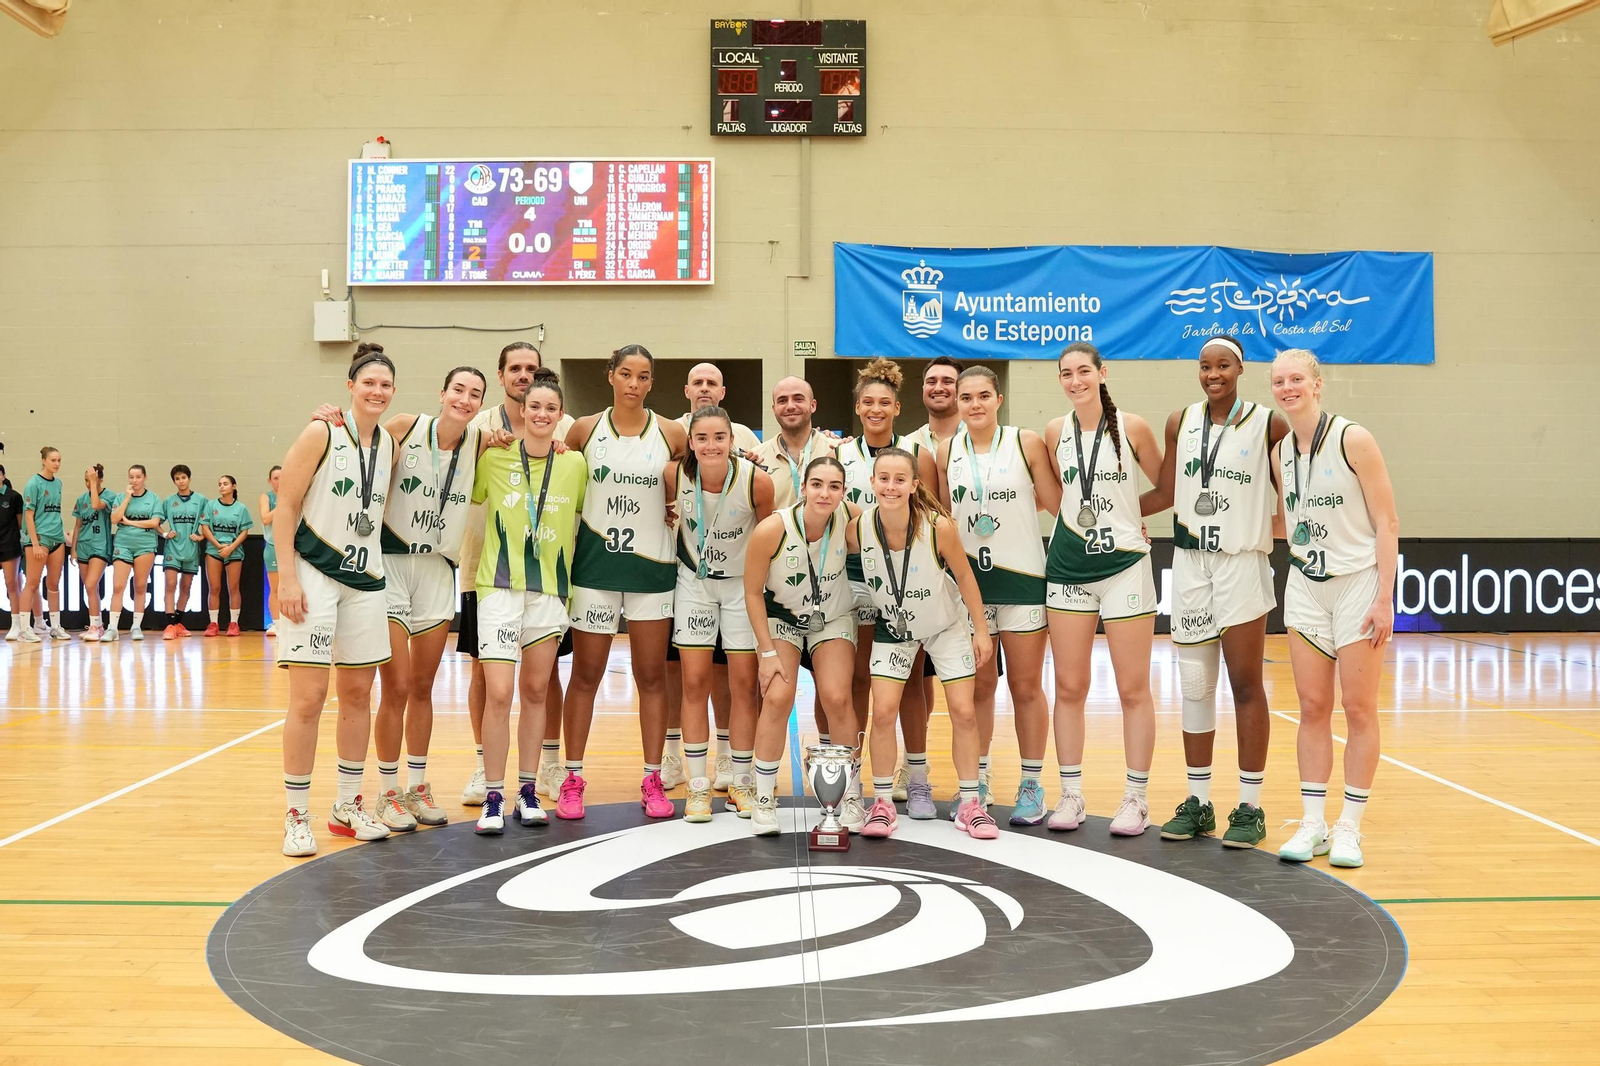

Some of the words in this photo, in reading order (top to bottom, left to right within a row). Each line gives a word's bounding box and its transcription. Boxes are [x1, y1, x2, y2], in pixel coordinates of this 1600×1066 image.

[719, 52, 759, 63] LOCAL
[818, 53, 858, 64] VISITANTE
[774, 83, 803, 92] PERIODO
[717, 123, 746, 132] FALTAS
[770, 123, 807, 132] JUGADOR
[833, 123, 862, 133] FALTAS
[498, 167, 562, 192] 73-69
[376, 185, 406, 193] PRADOS
[472, 196, 488, 206] CAB
[515, 196, 545, 205] PERIODO
[574, 196, 588, 205] UNI
[524, 207, 536, 221] 4
[628, 212, 673, 221] ZIMMERMAN
[468, 220, 482, 228] TM
[577, 220, 592, 228] TM
[629, 222, 658, 230] ROTERS
[508, 232, 551, 253] 0.0
[468, 246, 481, 260] 2
[626, 260, 640, 269] EKE
[469, 270, 487, 279] TOMÉ
[575, 270, 596, 279] PÉREZ
[627, 269, 655, 279] GARCÍA
[954, 291, 1101, 316] Ayuntamiento
[962, 320, 988, 340] de
[995, 320, 1093, 345] Estepona
[1182, 322, 1225, 339] Jardín
[1227, 323, 1239, 335] de
[1242, 322, 1256, 335] la
[1273, 322, 1306, 335] Costa
[1309, 324, 1327, 334] del
[1329, 319, 1352, 333] Sol
[614, 472, 658, 488] Unicaja
[1092, 470, 1127, 484] nicaja
[1214, 466, 1252, 485] nicaja
[970, 488, 1016, 502] Uicaja
[1308, 493, 1344, 508] nicaja
[607, 495, 640, 518] Mijas
[1081, 494, 1113, 518] ijas
[411, 510, 446, 533] Mijas
[92, 526, 100, 534] 16
[605, 526, 635, 553] 32
[1084, 526, 1116, 554] 25
[1200, 525, 1220, 552] 15
[340, 544, 369, 574] 20
[978, 545, 992, 572] 6
[1302, 549, 1326, 577] 21
